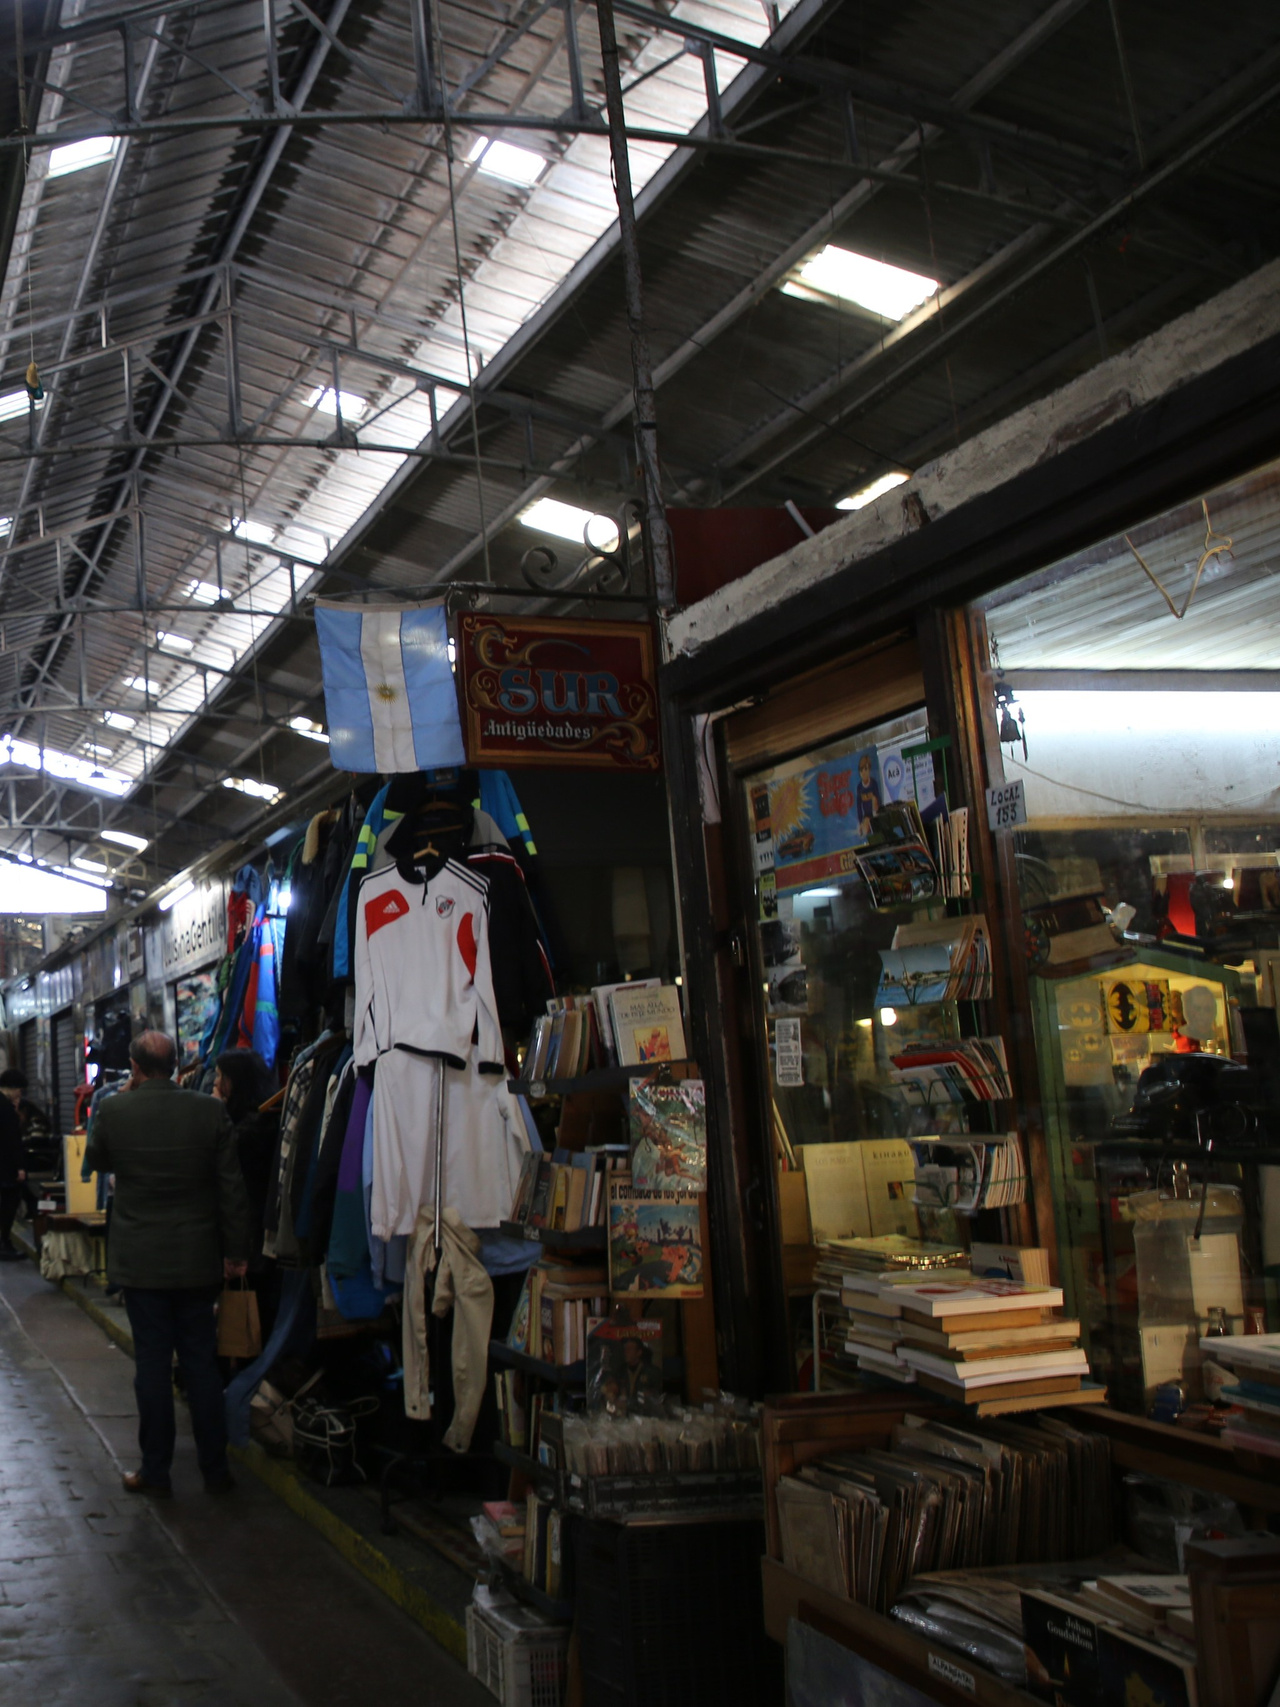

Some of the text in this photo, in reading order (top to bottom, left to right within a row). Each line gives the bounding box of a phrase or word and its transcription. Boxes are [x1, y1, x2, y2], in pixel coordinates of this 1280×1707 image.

[497, 667, 628, 717] SUR
[483, 718, 592, 741] Antigüedades
[991, 785, 1020, 806] LOCAL
[996, 801, 1017, 825] 153
[1066, 1615, 1092, 1637] Johan
